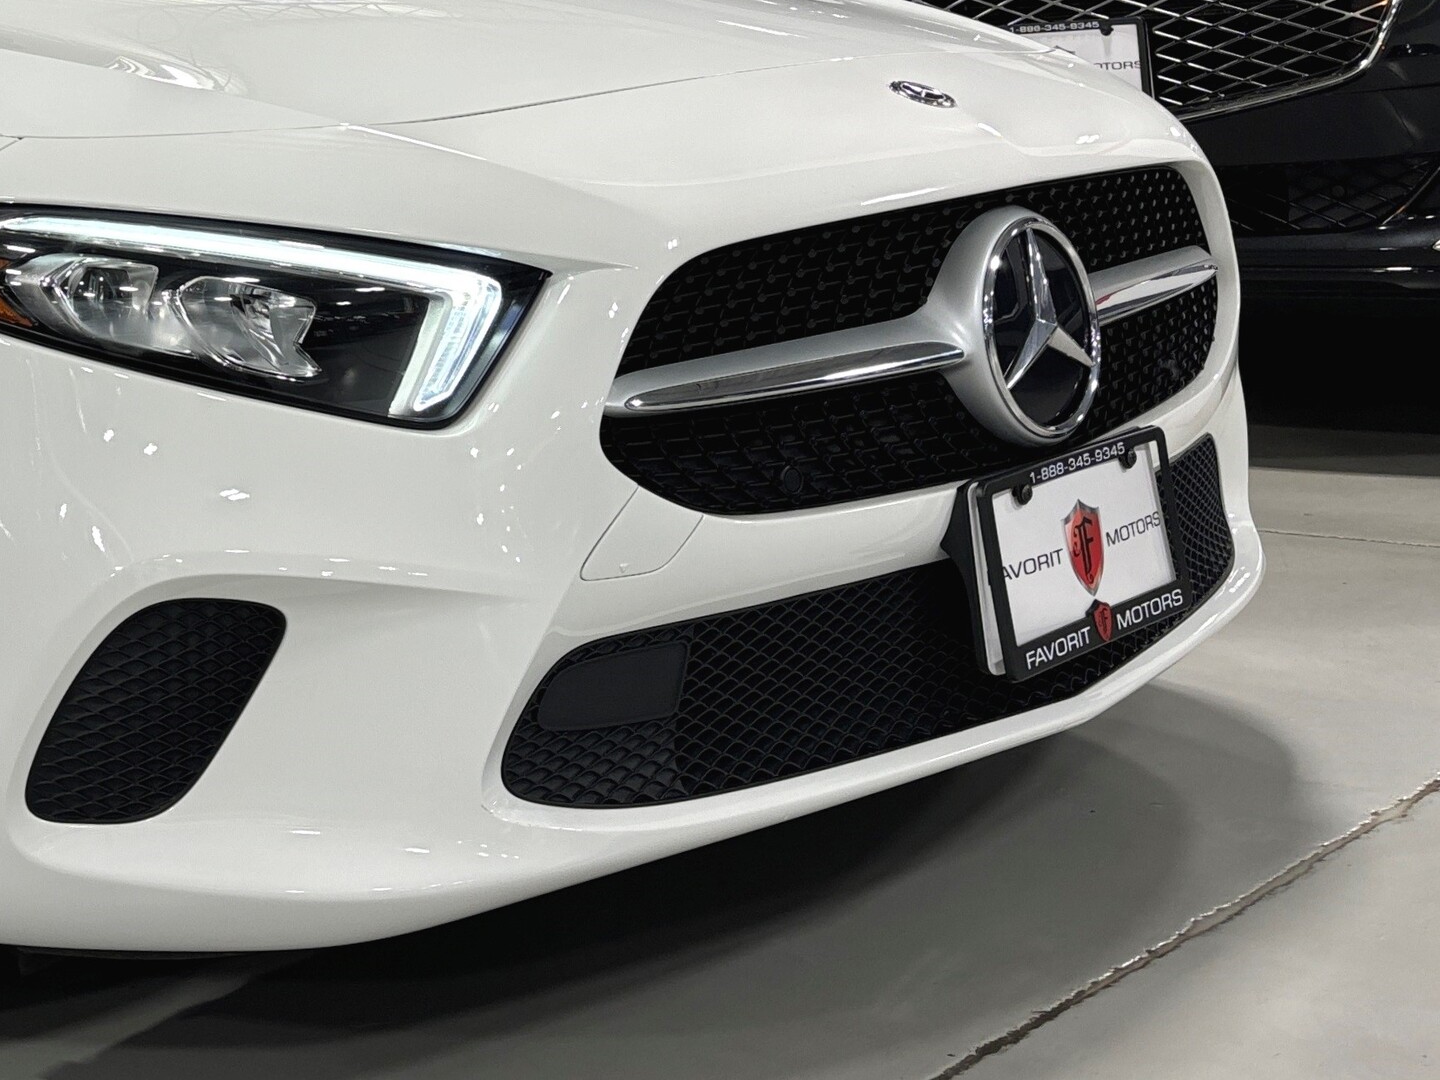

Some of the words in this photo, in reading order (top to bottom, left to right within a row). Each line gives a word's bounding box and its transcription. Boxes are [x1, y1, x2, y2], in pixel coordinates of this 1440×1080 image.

[1029, 441, 1126, 483] 1-888-345-9345
[1105, 511, 1161, 547] MOTORS
[1025, 626, 1091, 670] FAVORIT
[1116, 589, 1184, 631] MOTORS
